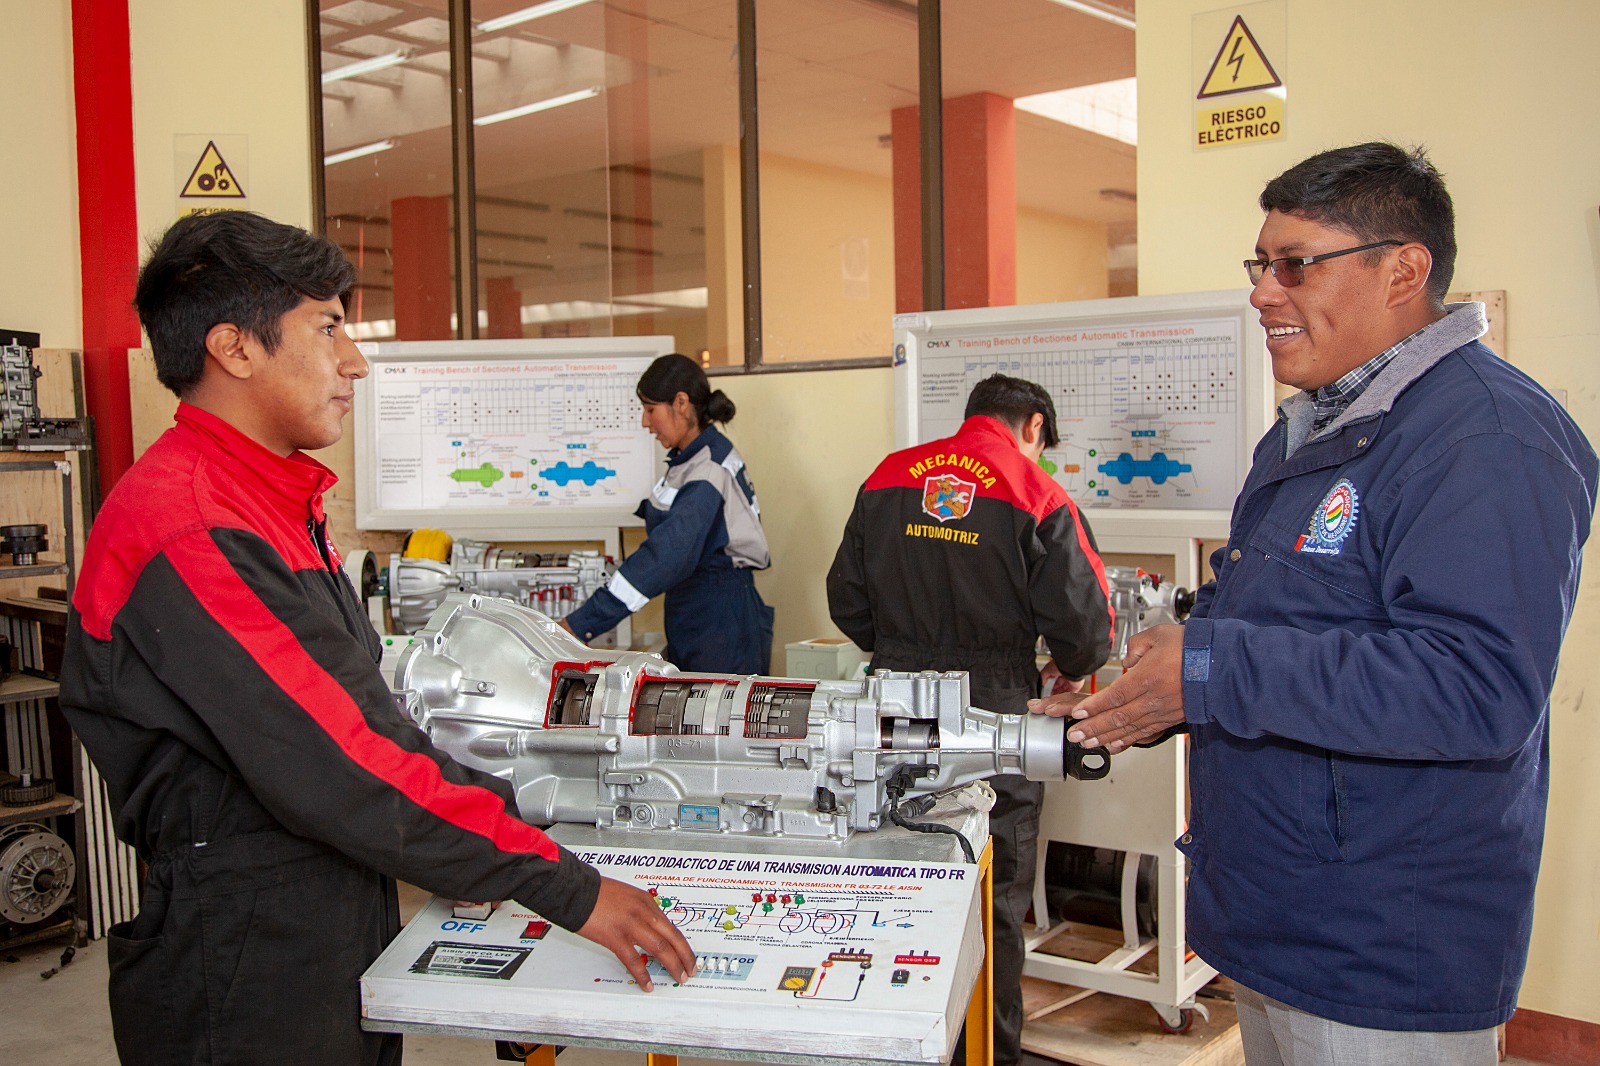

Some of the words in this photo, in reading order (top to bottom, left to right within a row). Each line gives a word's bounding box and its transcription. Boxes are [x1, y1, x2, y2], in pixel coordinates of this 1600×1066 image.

[1212, 106, 1266, 126] RIESGO
[1198, 122, 1280, 144] ELÉCTRICO
[958, 339, 992, 348] Training
[994, 337, 1020, 346] Bench
[1022, 336, 1031, 344] of
[1033, 334, 1078, 344] Sectioned
[1082, 330, 1128, 341] Automatic
[1130, 327, 1194, 338] Transmission
[414, 367, 445, 375] Training
[447, 366, 471, 374] Bench
[482, 365, 520, 373] Sectioned
[909, 454, 996, 489] MECANICA
[906, 523, 979, 545] AUTOMOTRIZ
[581, 853, 598, 864] DE
[597, 854, 615, 865] UN
[614, 855, 655, 867] BANCO
[656, 856, 717, 870] DIDACTICO
[718, 859, 736, 871] DE
[737, 860, 761, 872] UNA
[764, 861, 842, 876] TRANSMISION
[842, 864, 917, 878] AUTOMATICA
[920, 868, 946, 879] TIPO
[949, 869, 966, 880] FR
[697, 877, 776, 886] FUNCIONAMIENTO
[781, 881, 843, 889] TRANSMISION
[441, 920, 487, 933] OFF
